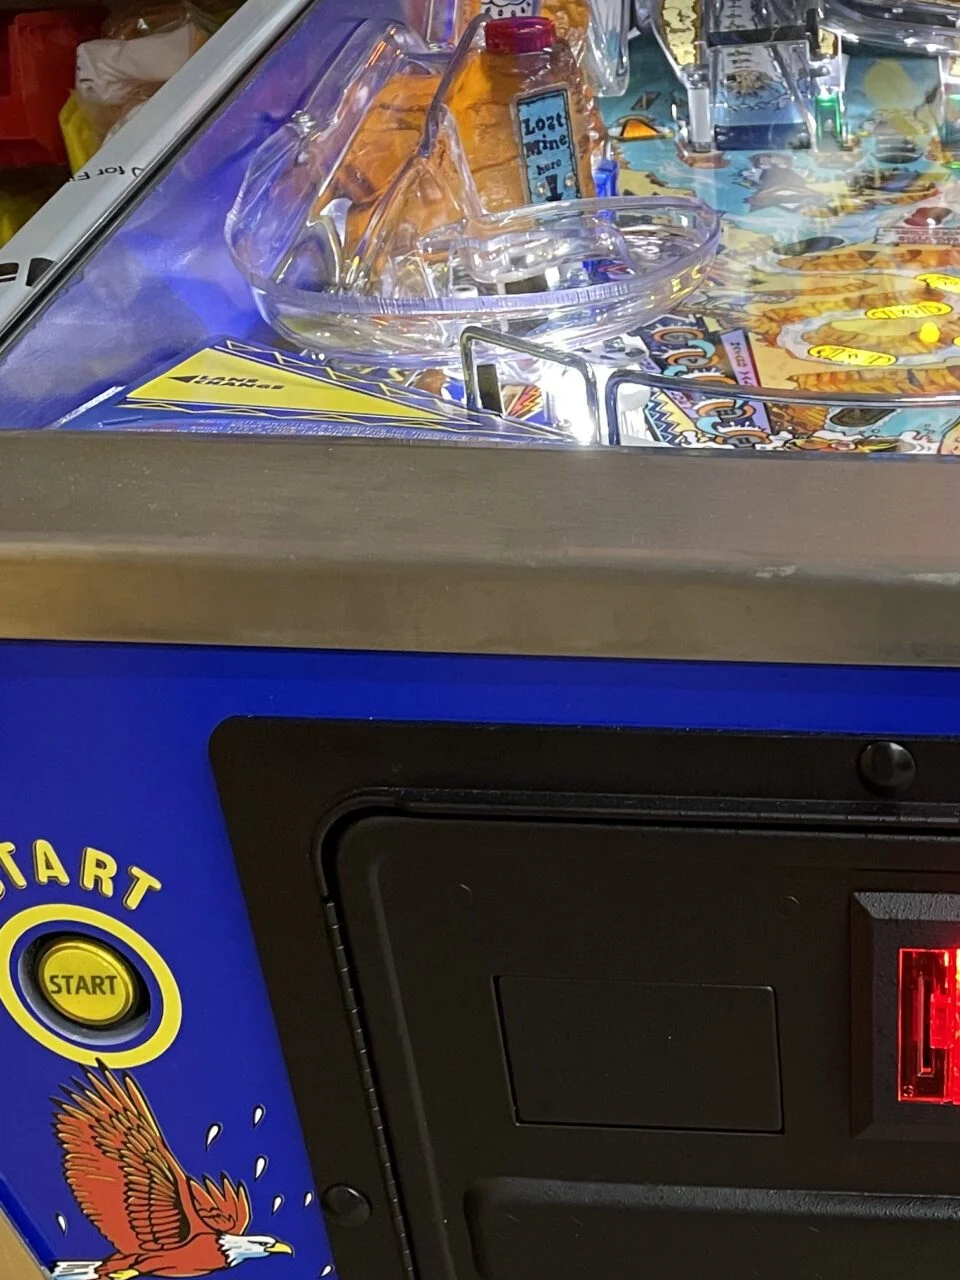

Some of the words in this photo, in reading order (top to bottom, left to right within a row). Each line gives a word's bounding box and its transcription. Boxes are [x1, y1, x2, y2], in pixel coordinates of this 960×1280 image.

[524, 134, 569, 157] Mine
[536, 160, 562, 176] here
[193, 380, 285, 390] CHANGE
[49, 975, 117, 995] START
